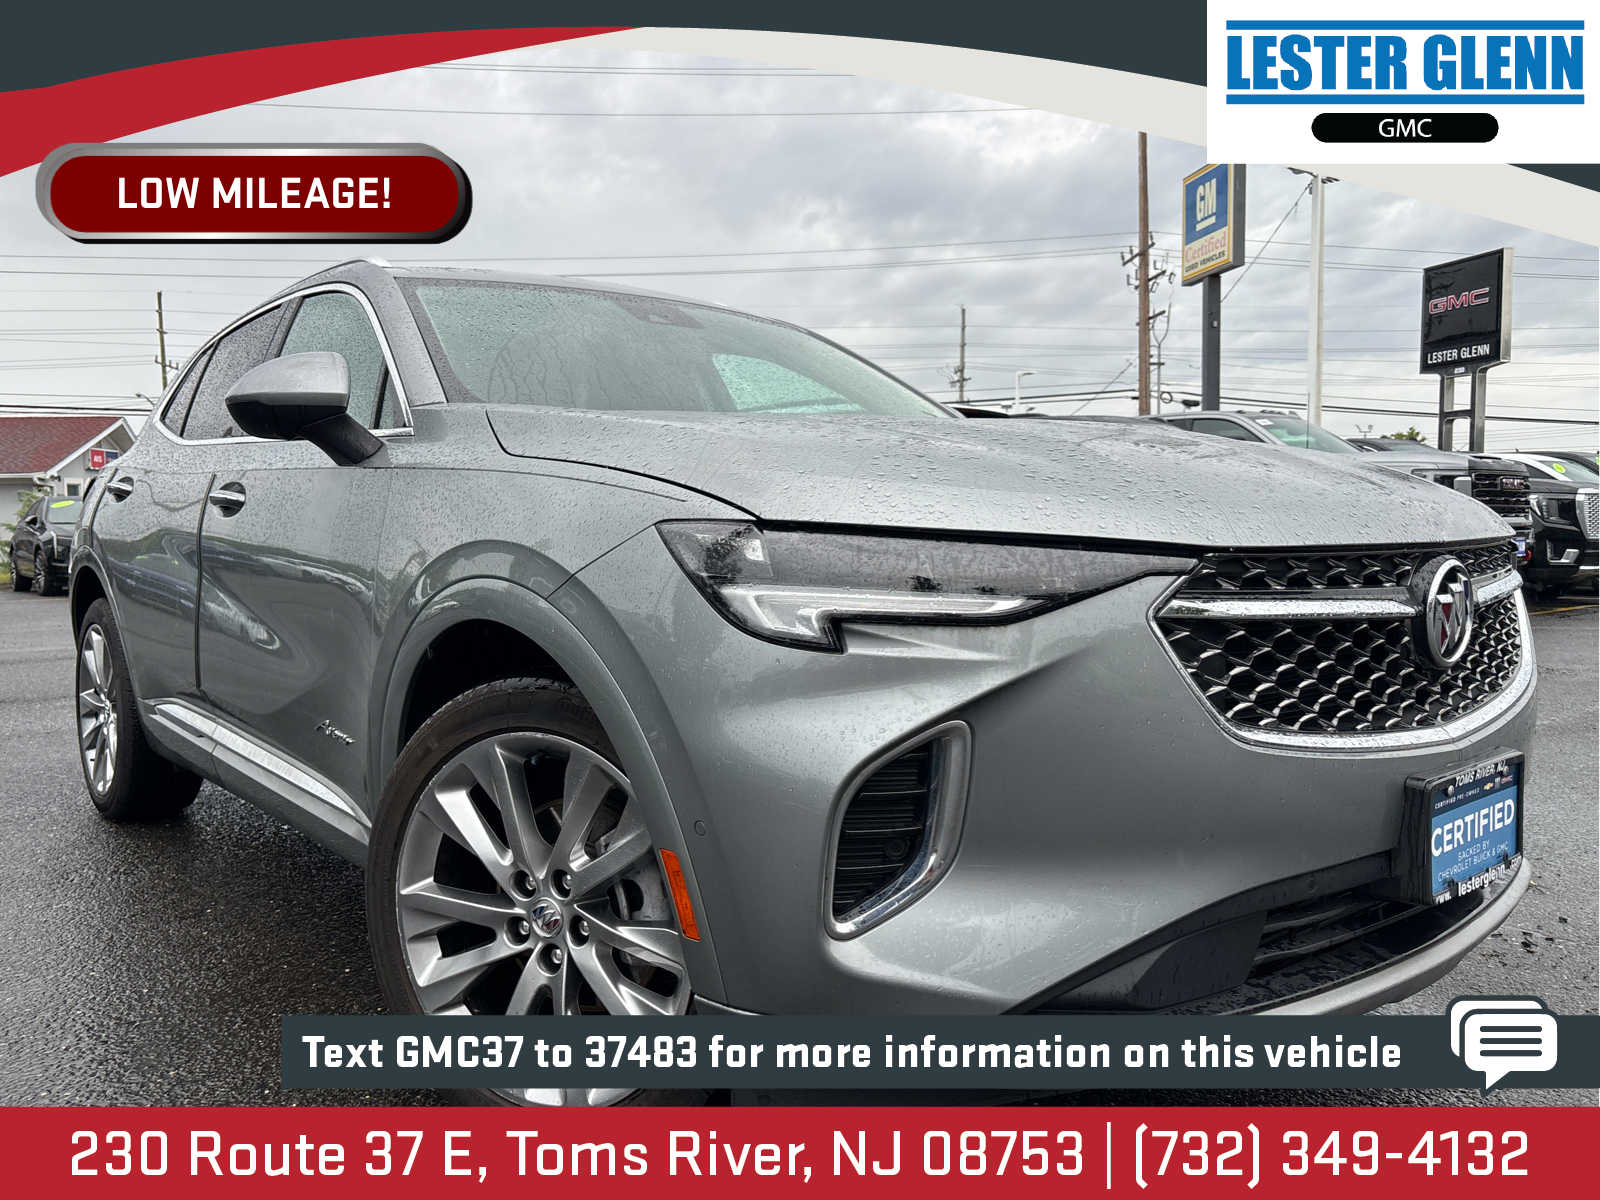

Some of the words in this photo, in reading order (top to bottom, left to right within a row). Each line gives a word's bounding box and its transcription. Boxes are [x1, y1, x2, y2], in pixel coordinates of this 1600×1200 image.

[1196, 178, 1216, 221] GM
[1185, 230, 1226, 263] Certified
[1429, 287, 1489, 314] GMC
[1428, 348, 1458, 364] LESTER
[1461, 344, 1489, 359] GLENN
[1455, 771, 1475, 787] TOMS
[1432, 799, 1514, 856] CERTIFIED
[1482, 840, 1489, 850] BY
[1438, 858, 1472, 882] CHEVROLET
[1473, 850, 1490, 864] BUICK
